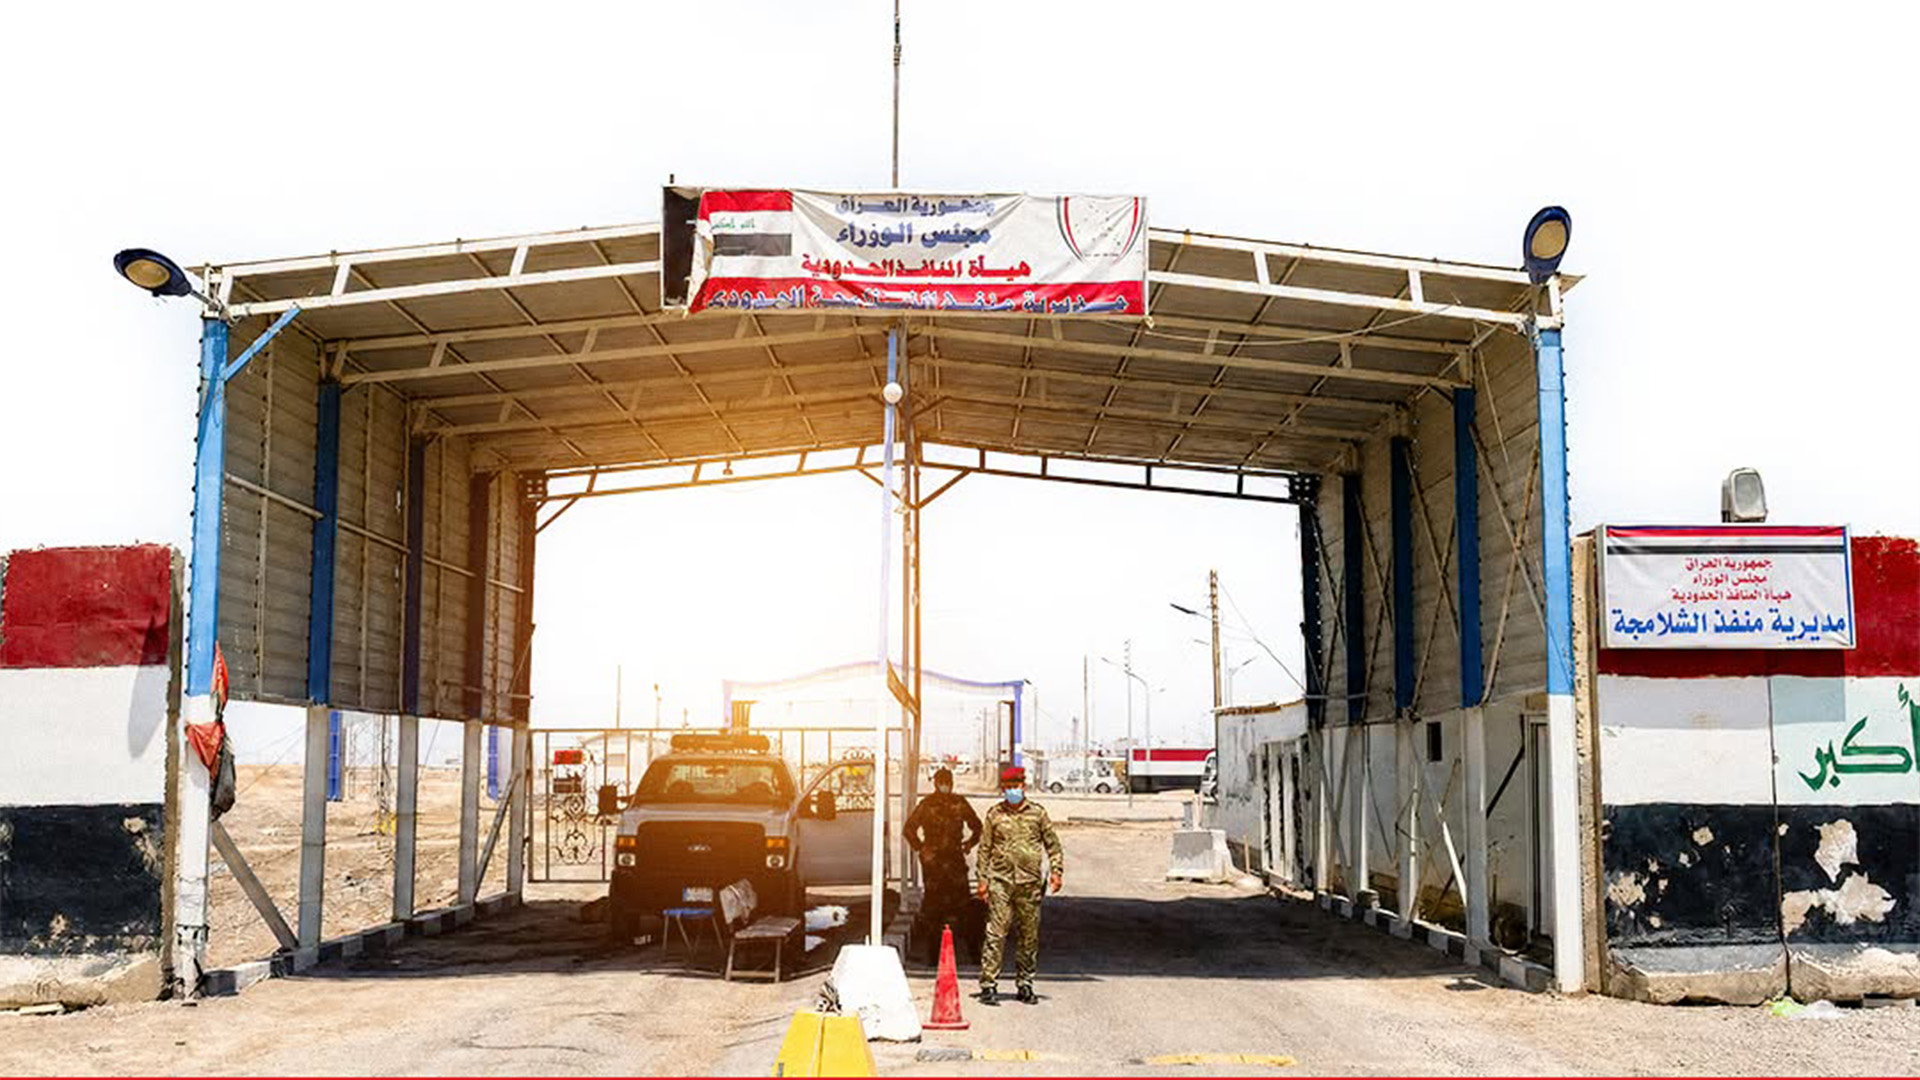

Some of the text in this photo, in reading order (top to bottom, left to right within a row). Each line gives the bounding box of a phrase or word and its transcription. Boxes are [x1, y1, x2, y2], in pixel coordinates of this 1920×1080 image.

[836, 222, 912, 248] الوزراء
[1685, 556, 1773, 571] جمهورية العراق
[1693, 573, 1767, 587] مجلس الوزراء
[1671, 588, 1723, 604] الحدودية
[1726, 589, 1762, 601] المنافذ
[1611, 608, 1846, 641] مديرية منفذ الشلامجة
